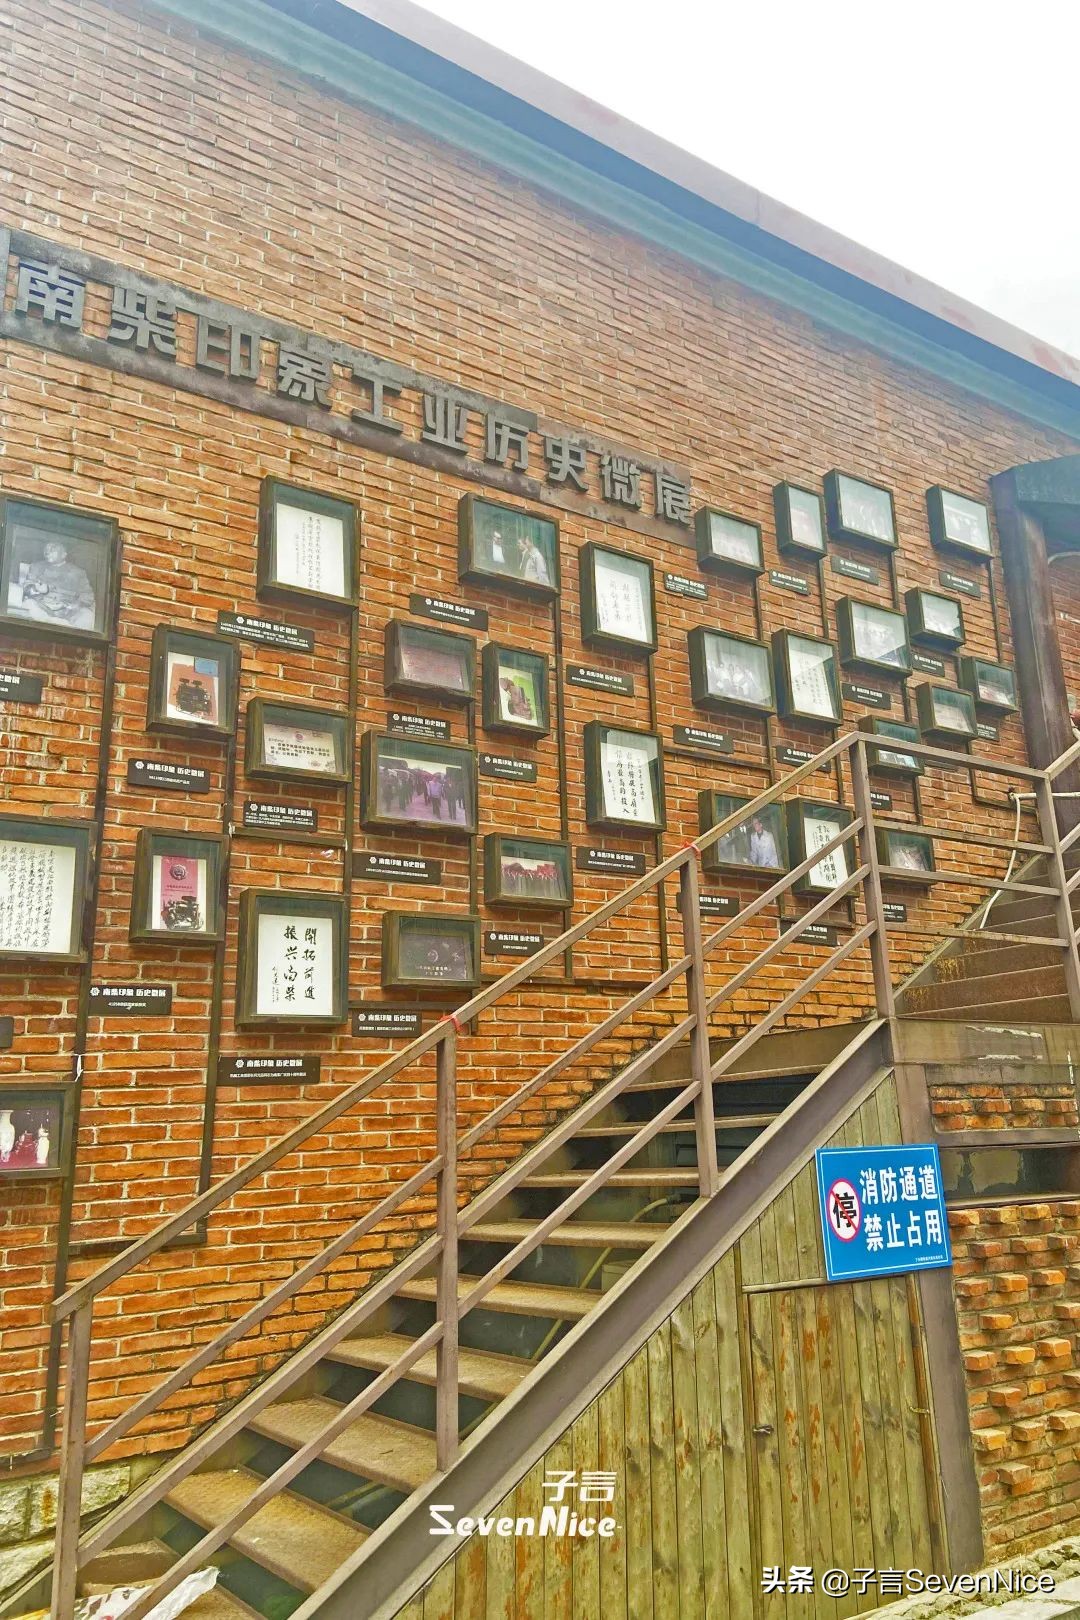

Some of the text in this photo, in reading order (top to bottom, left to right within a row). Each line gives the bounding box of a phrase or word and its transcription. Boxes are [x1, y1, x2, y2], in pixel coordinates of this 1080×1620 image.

[15, 258, 691, 525] 南柴印象工业历史微展
[860, 1165, 938, 1205] 消防通道
[833, 1192, 857, 1229] 停
[864, 1209, 943, 1252] 禁止占用
